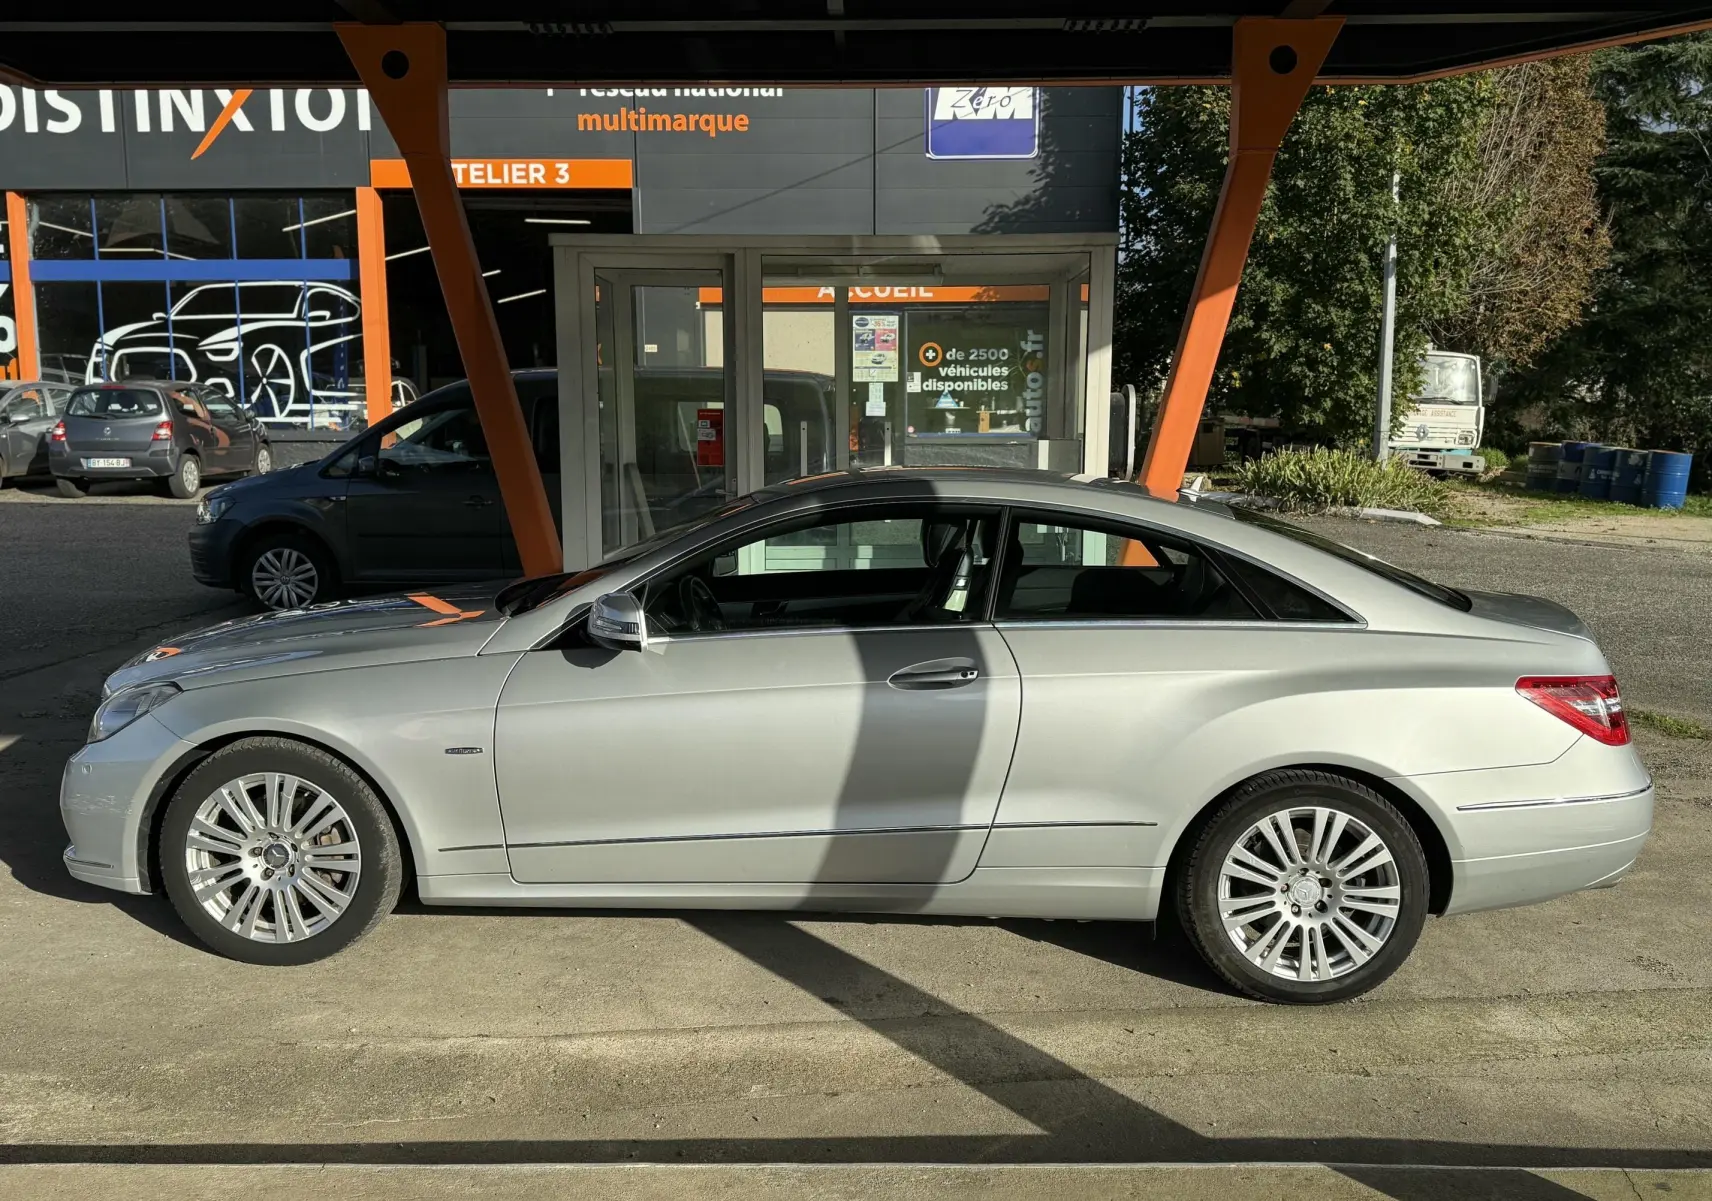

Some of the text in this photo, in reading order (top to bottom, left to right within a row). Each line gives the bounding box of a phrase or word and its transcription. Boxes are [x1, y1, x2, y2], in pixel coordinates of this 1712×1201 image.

[577, 107, 749, 137] multimarque
[452, 163, 570, 185] TELIER 3
[817, 286, 934, 298] ACUEIL
[945, 348, 965, 360] de
[968, 348, 1009, 361] 2500
[939, 364, 1009, 377] véhicules
[922, 378, 1009, 394] disponibles
